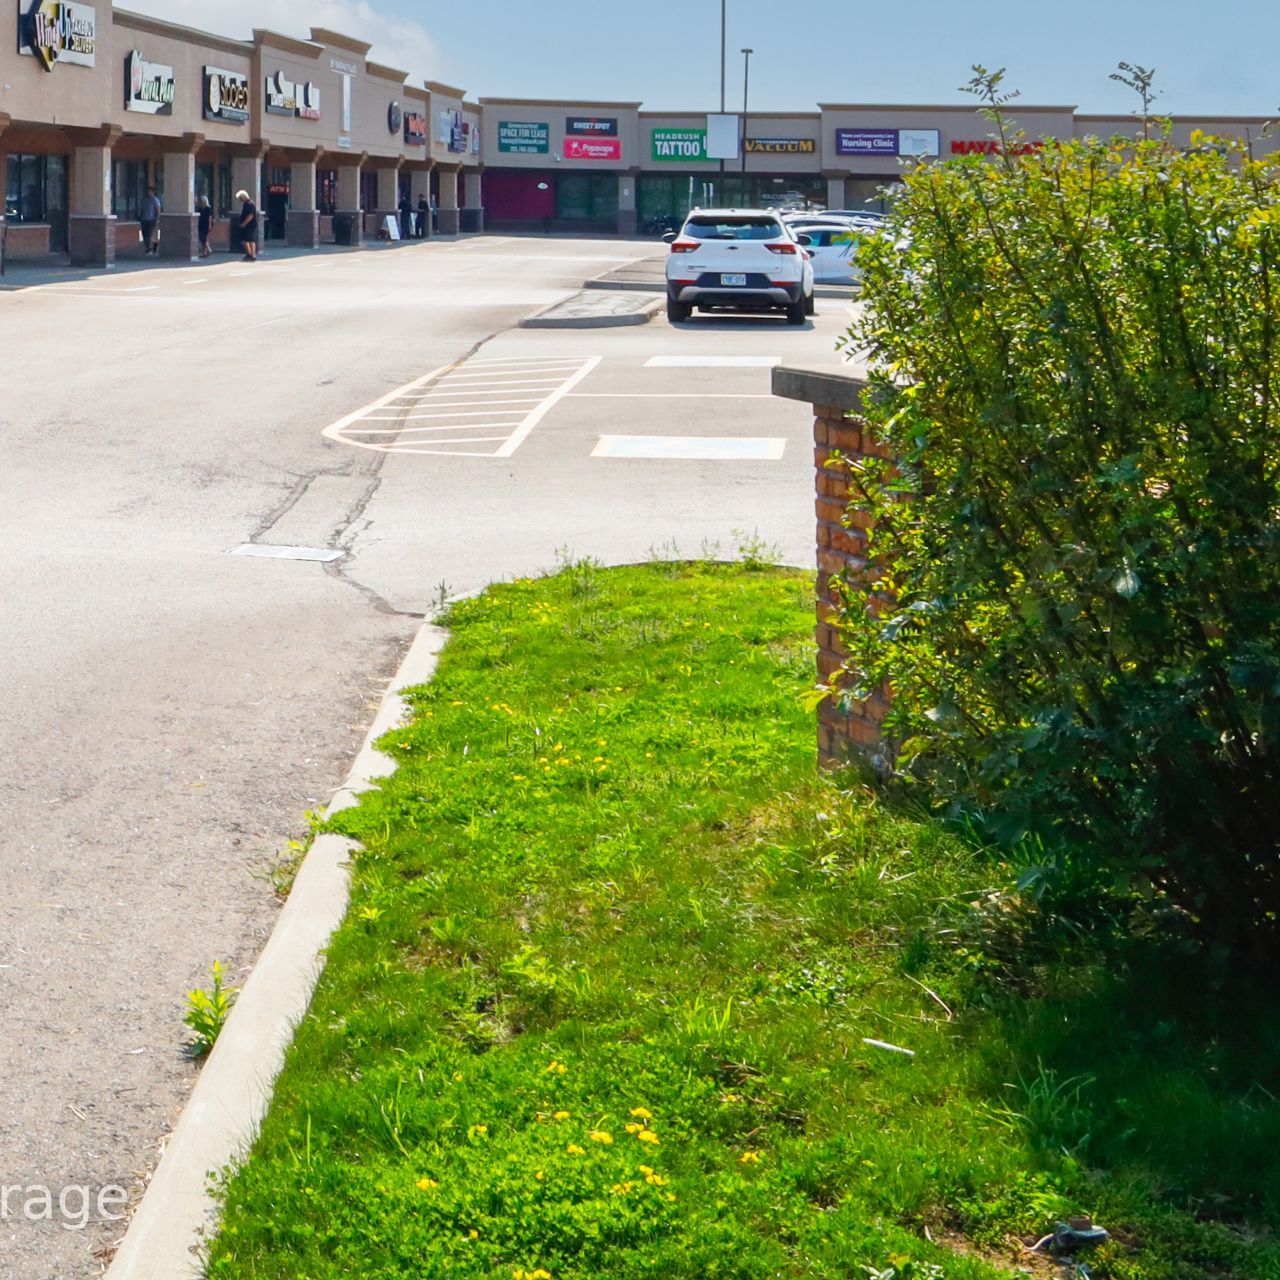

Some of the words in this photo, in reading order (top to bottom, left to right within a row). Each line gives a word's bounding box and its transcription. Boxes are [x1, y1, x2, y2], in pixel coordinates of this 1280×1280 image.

[500, 128, 518, 137] SPACE
[531, 129, 547, 138] LEASE
[655, 141, 700, 156] TATTOO
[745, 140, 813, 151] VACUUM
[842, 139, 872, 148] Nursing
[873, 139, 894, 148] Clinic
